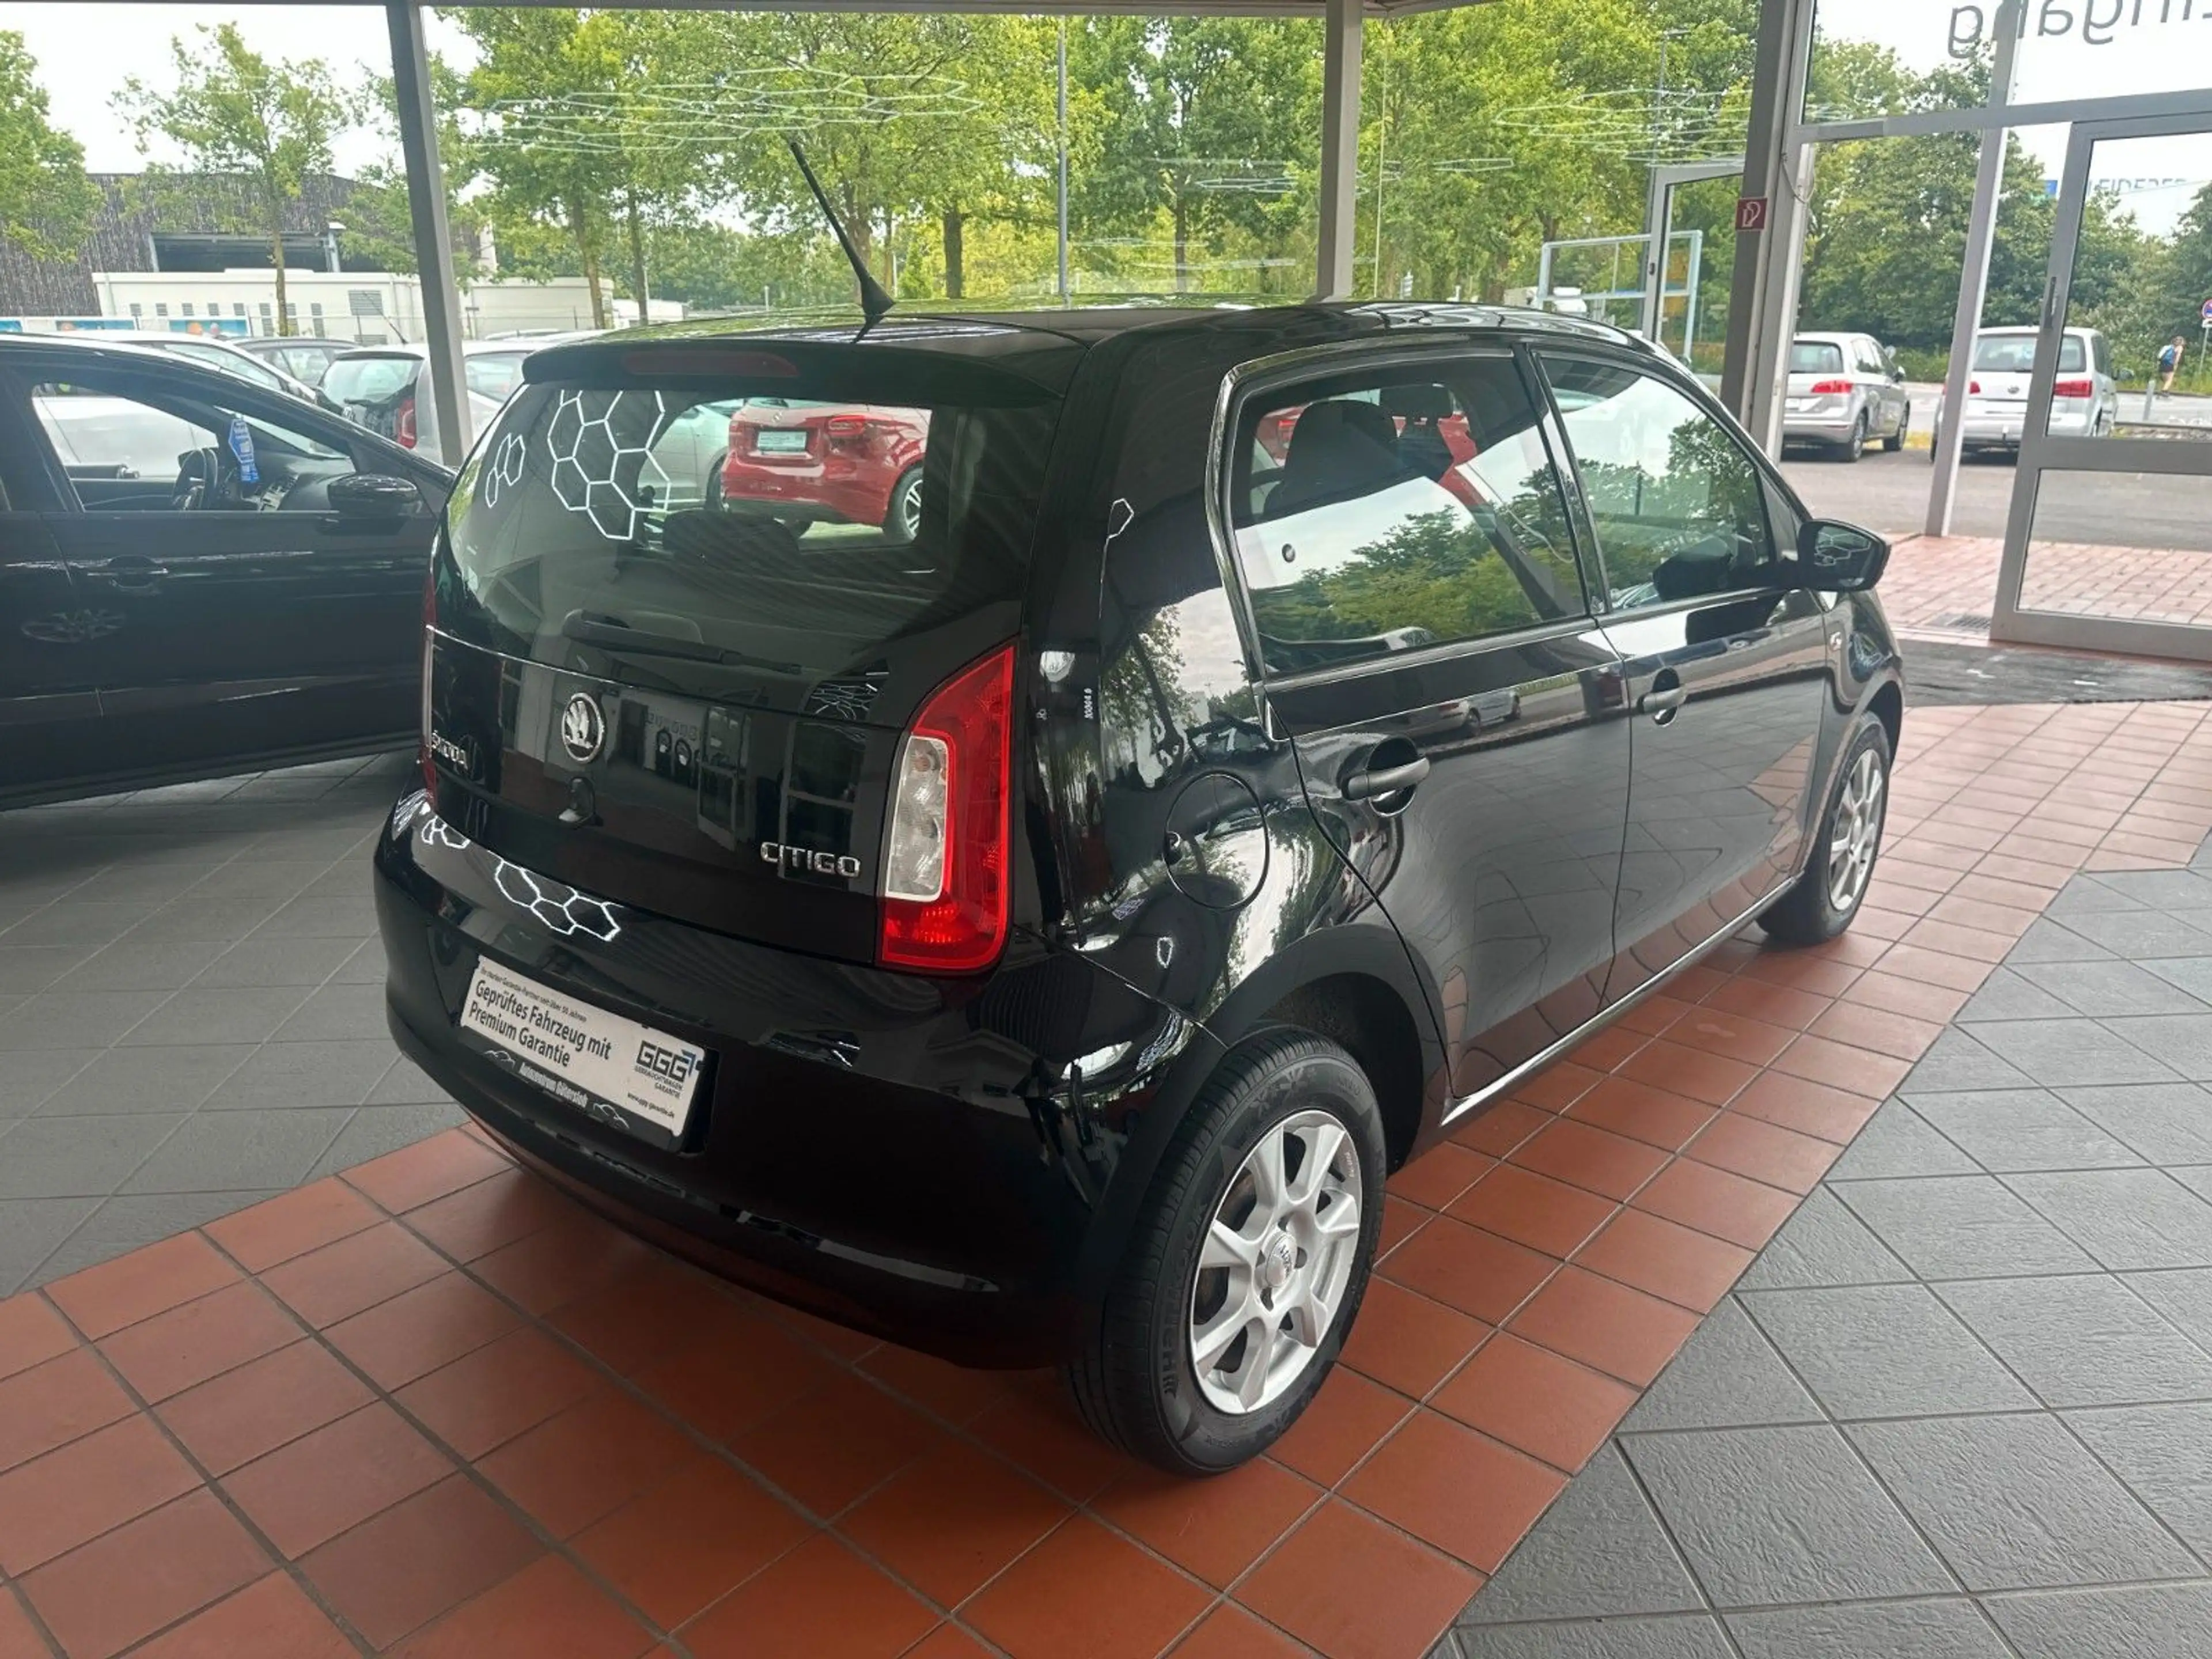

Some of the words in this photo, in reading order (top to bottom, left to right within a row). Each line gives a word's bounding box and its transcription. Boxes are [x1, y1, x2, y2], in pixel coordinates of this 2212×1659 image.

[760, 842, 861, 877] CITIGO
[468, 1001, 517, 1040] Premium
[518, 1027, 570, 1066] Garantie
[476, 980, 529, 1020] Geprüftes
[529, 1005, 587, 1052] Fahrzeug
[587, 1037, 612, 1059] mit
[636, 1040, 690, 1082] GGG
